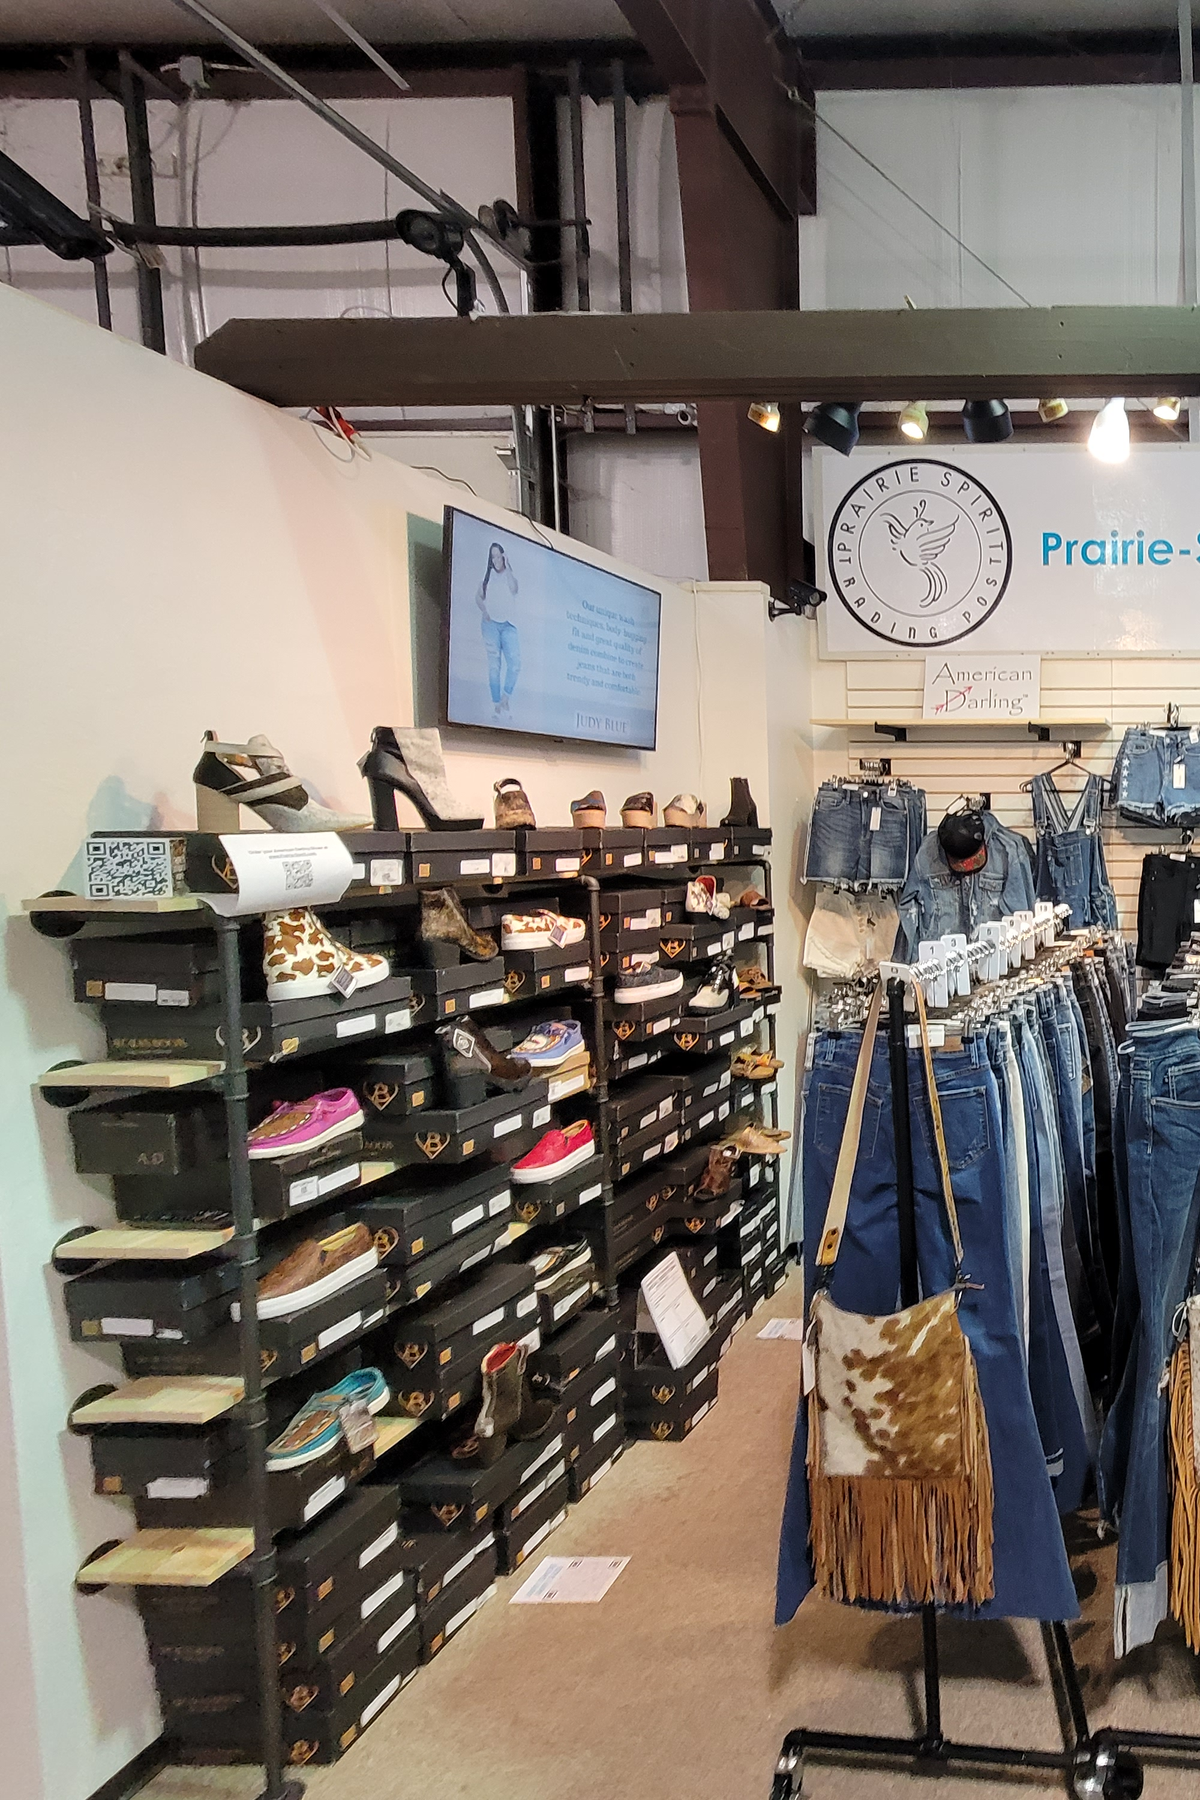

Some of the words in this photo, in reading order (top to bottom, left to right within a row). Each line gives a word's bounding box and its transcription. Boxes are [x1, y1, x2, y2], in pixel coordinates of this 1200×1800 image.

[837, 466, 920, 552] PRAIRIE
[940, 471, 1004, 551] SPIRIT
[961, 557, 1002, 624] POST
[931, 662, 1033, 686] American
[576, 712, 603, 730] JUDY
[604, 716, 628, 734] BLUE
